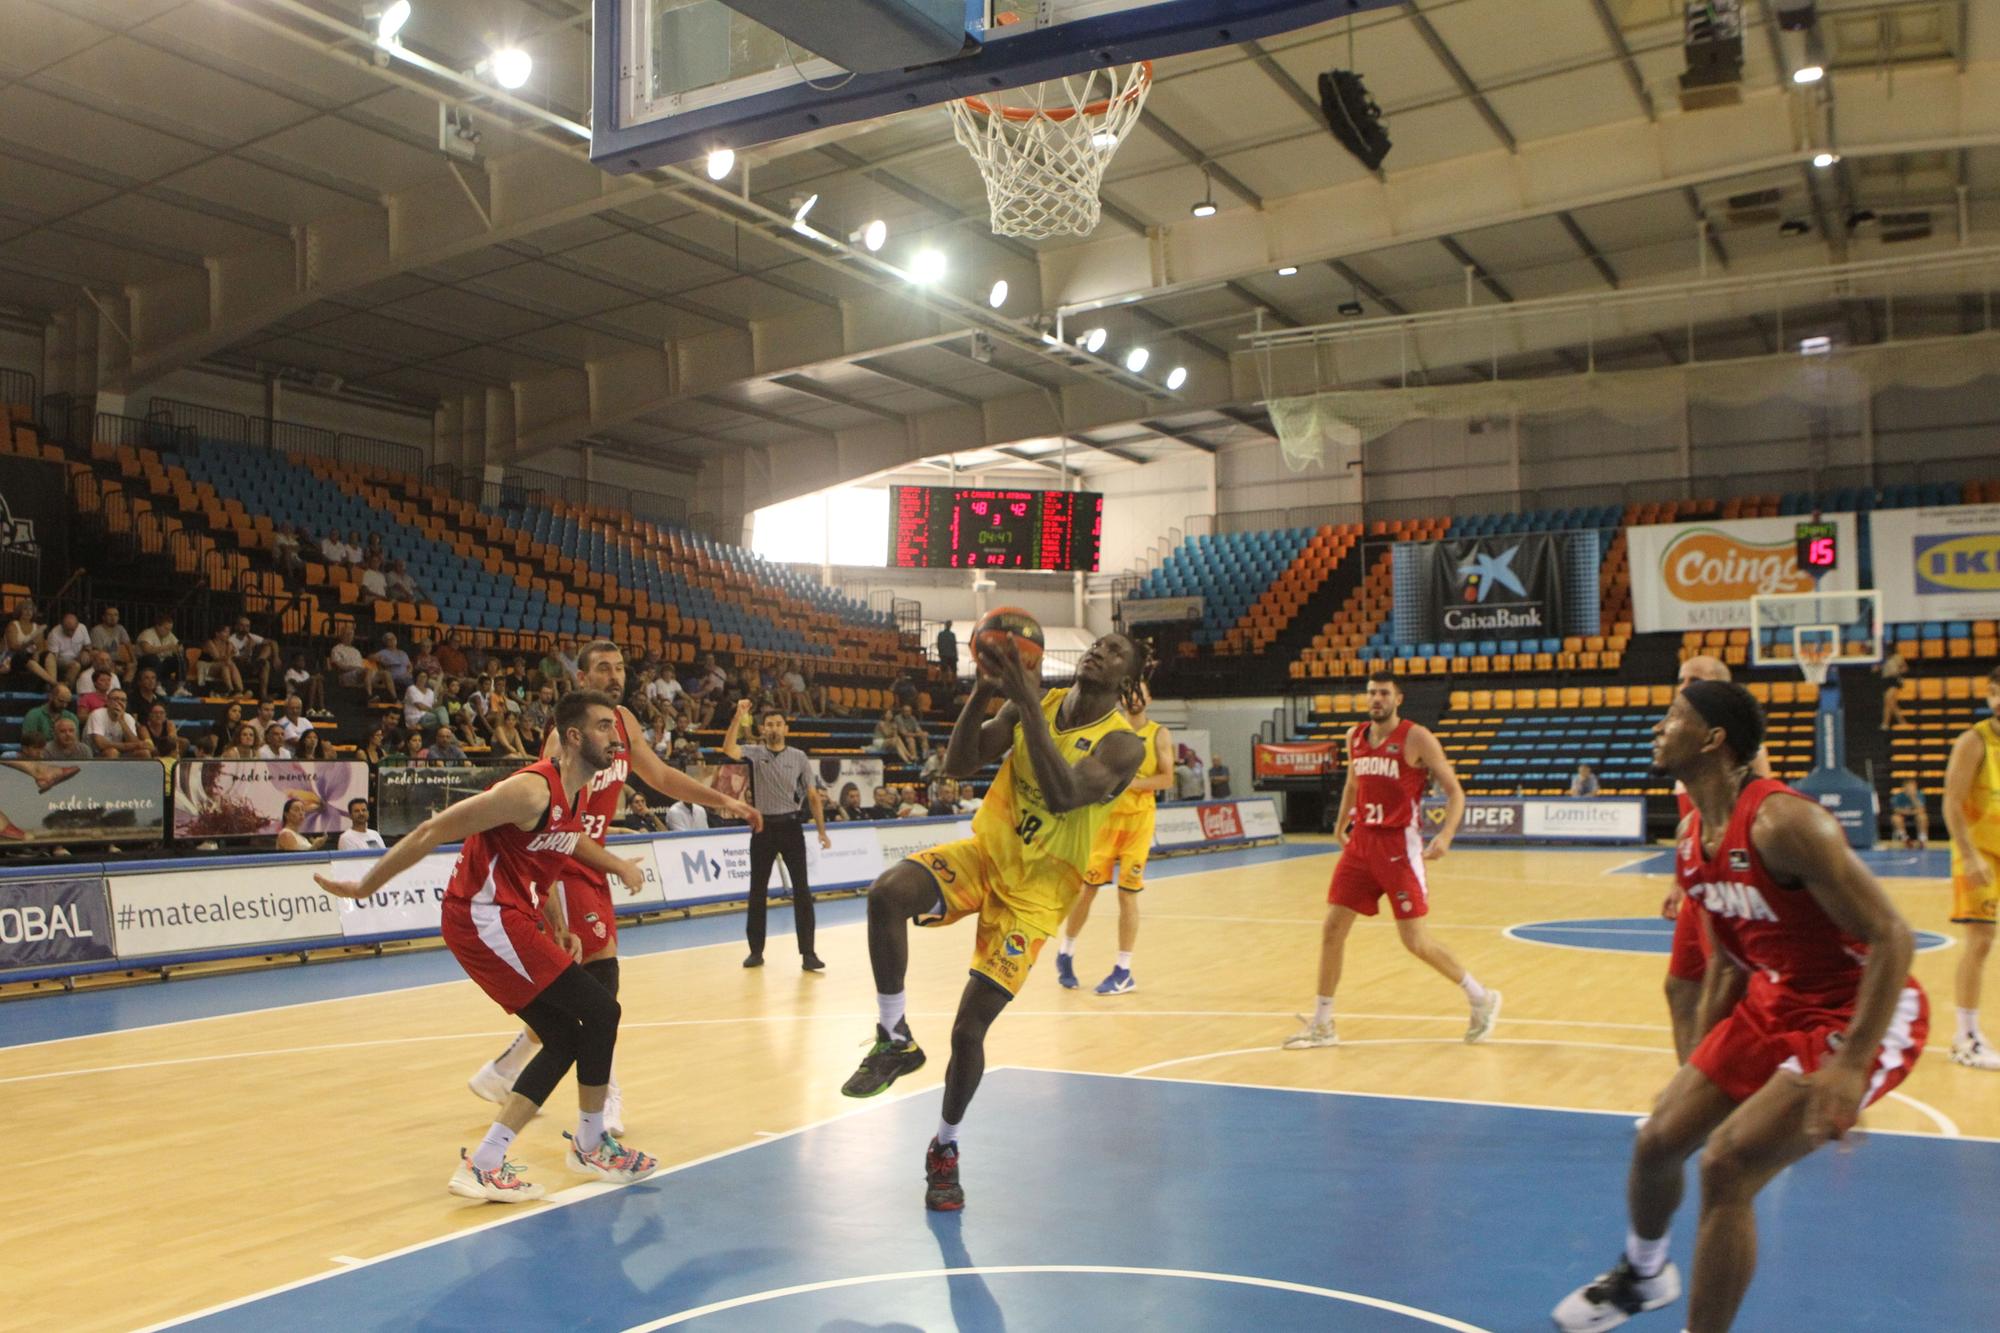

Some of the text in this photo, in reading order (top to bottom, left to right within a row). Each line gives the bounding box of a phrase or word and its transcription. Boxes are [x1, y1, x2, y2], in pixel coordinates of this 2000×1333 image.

[971, 502, 1027, 516] 48 42
[992, 514, 1002, 526] 3
[1809, 538, 1834, 565] 15
[1443, 607, 1543, 631] CaixaBank
[48, 795, 153, 811] made in menorca
[1364, 803, 1384, 824] 21
[1543, 804, 1619, 822] Lomitec
[583, 815, 606, 839] 33
[117, 893, 332, 930] #matealestigma
[0, 903, 93, 944] OBAL
